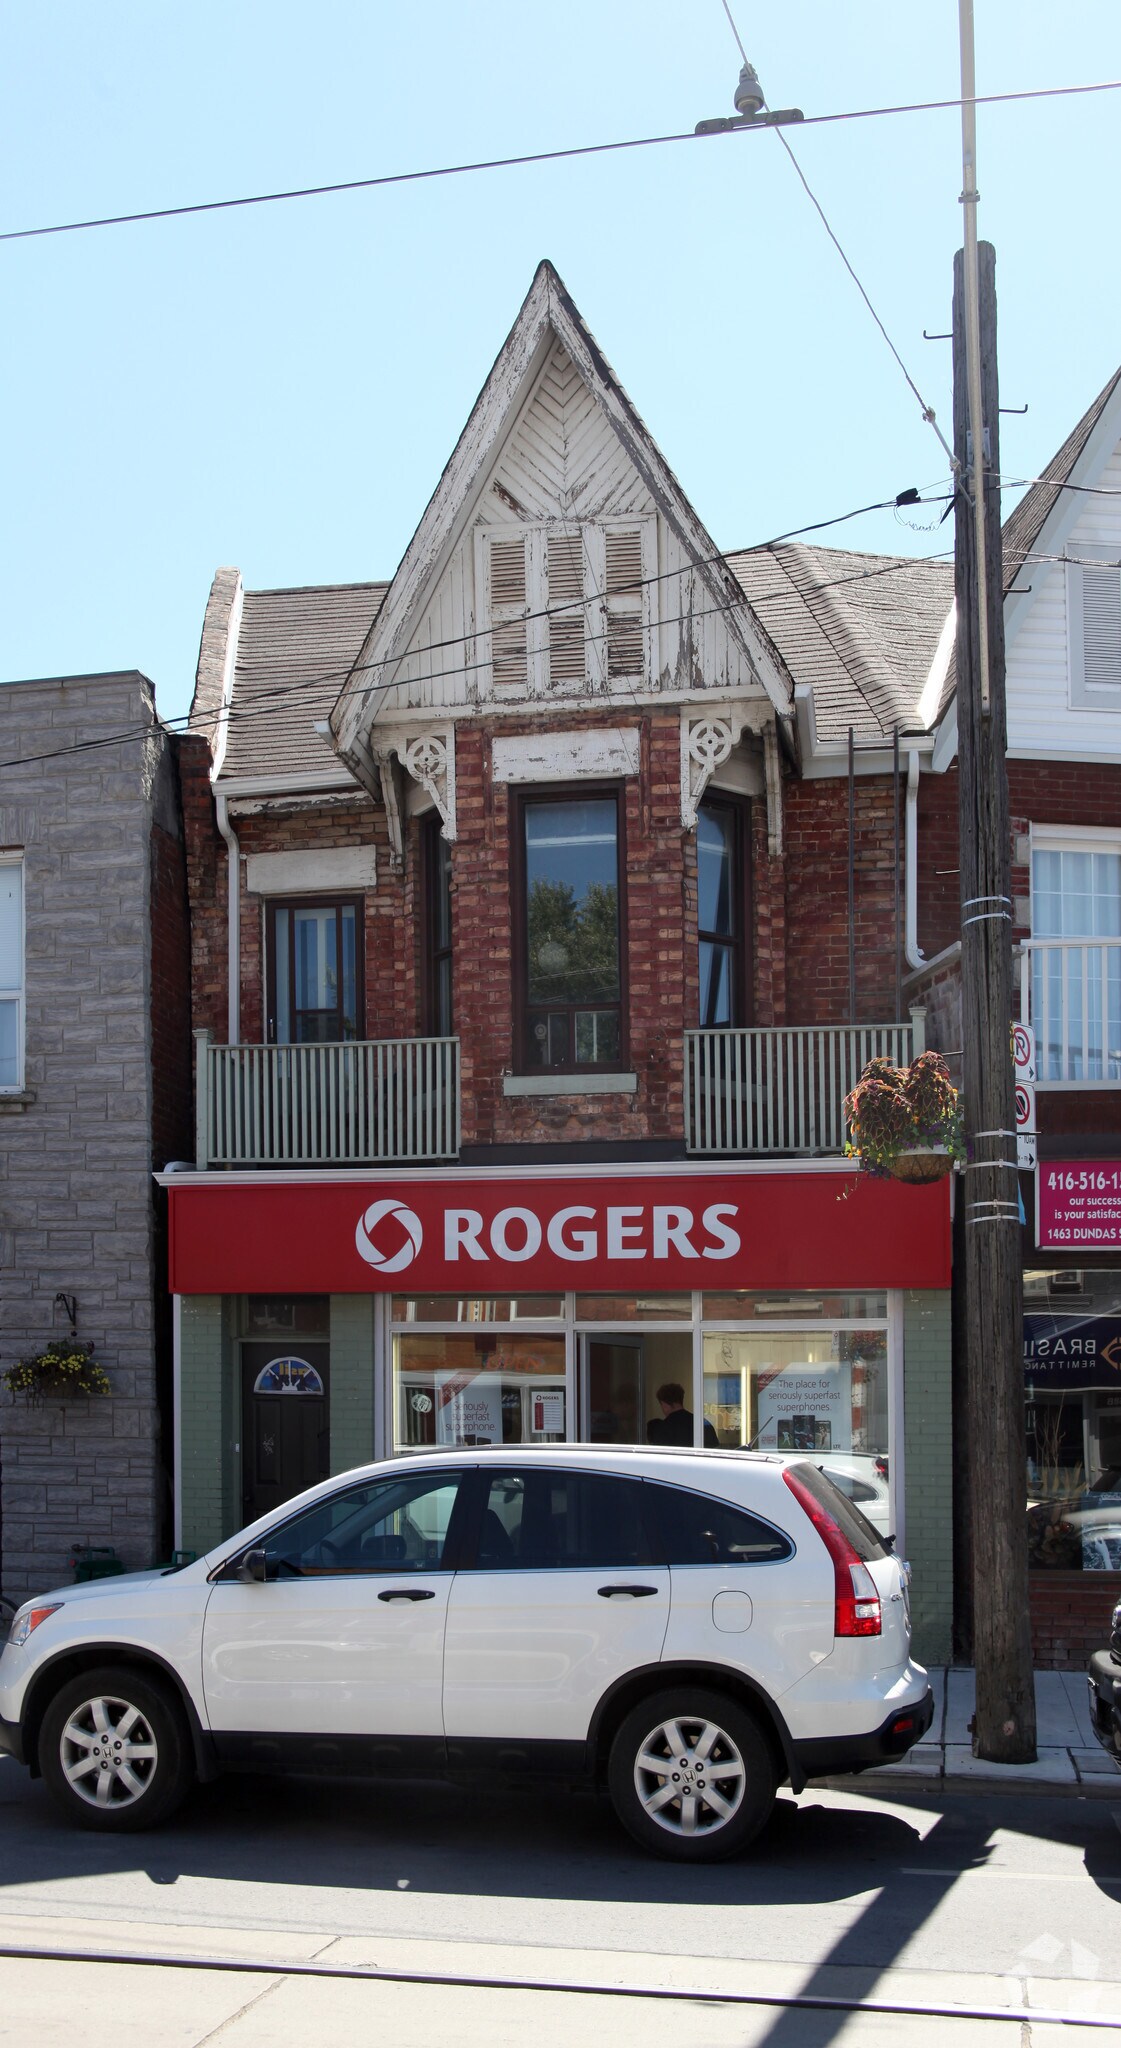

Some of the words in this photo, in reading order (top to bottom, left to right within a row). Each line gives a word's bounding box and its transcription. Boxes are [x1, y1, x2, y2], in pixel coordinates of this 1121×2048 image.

[1048, 1171, 1121, 1190] 416-516-1
[1069, 1197, 1085, 1206] our
[1087, 1197, 1121, 1206] success
[1054, 1209, 1062, 1219] is
[1064, 1211, 1085, 1221] your
[444, 1203, 742, 1262] ROGERS
[1048, 1228, 1071, 1239] 1463
[1073, 1228, 1117, 1239] DUNDAS
[779, 1380, 794, 1389] The
[795, 1380, 817, 1390] place
[819, 1380, 831, 1389] for
[768, 1391, 802, 1401] seriously
[804, 1391, 841, 1401] superfast
[453, 1401, 489, 1411] Seriously
[452, 1411, 490, 1422] superfast
[445, 1422, 497, 1433] superphone.
